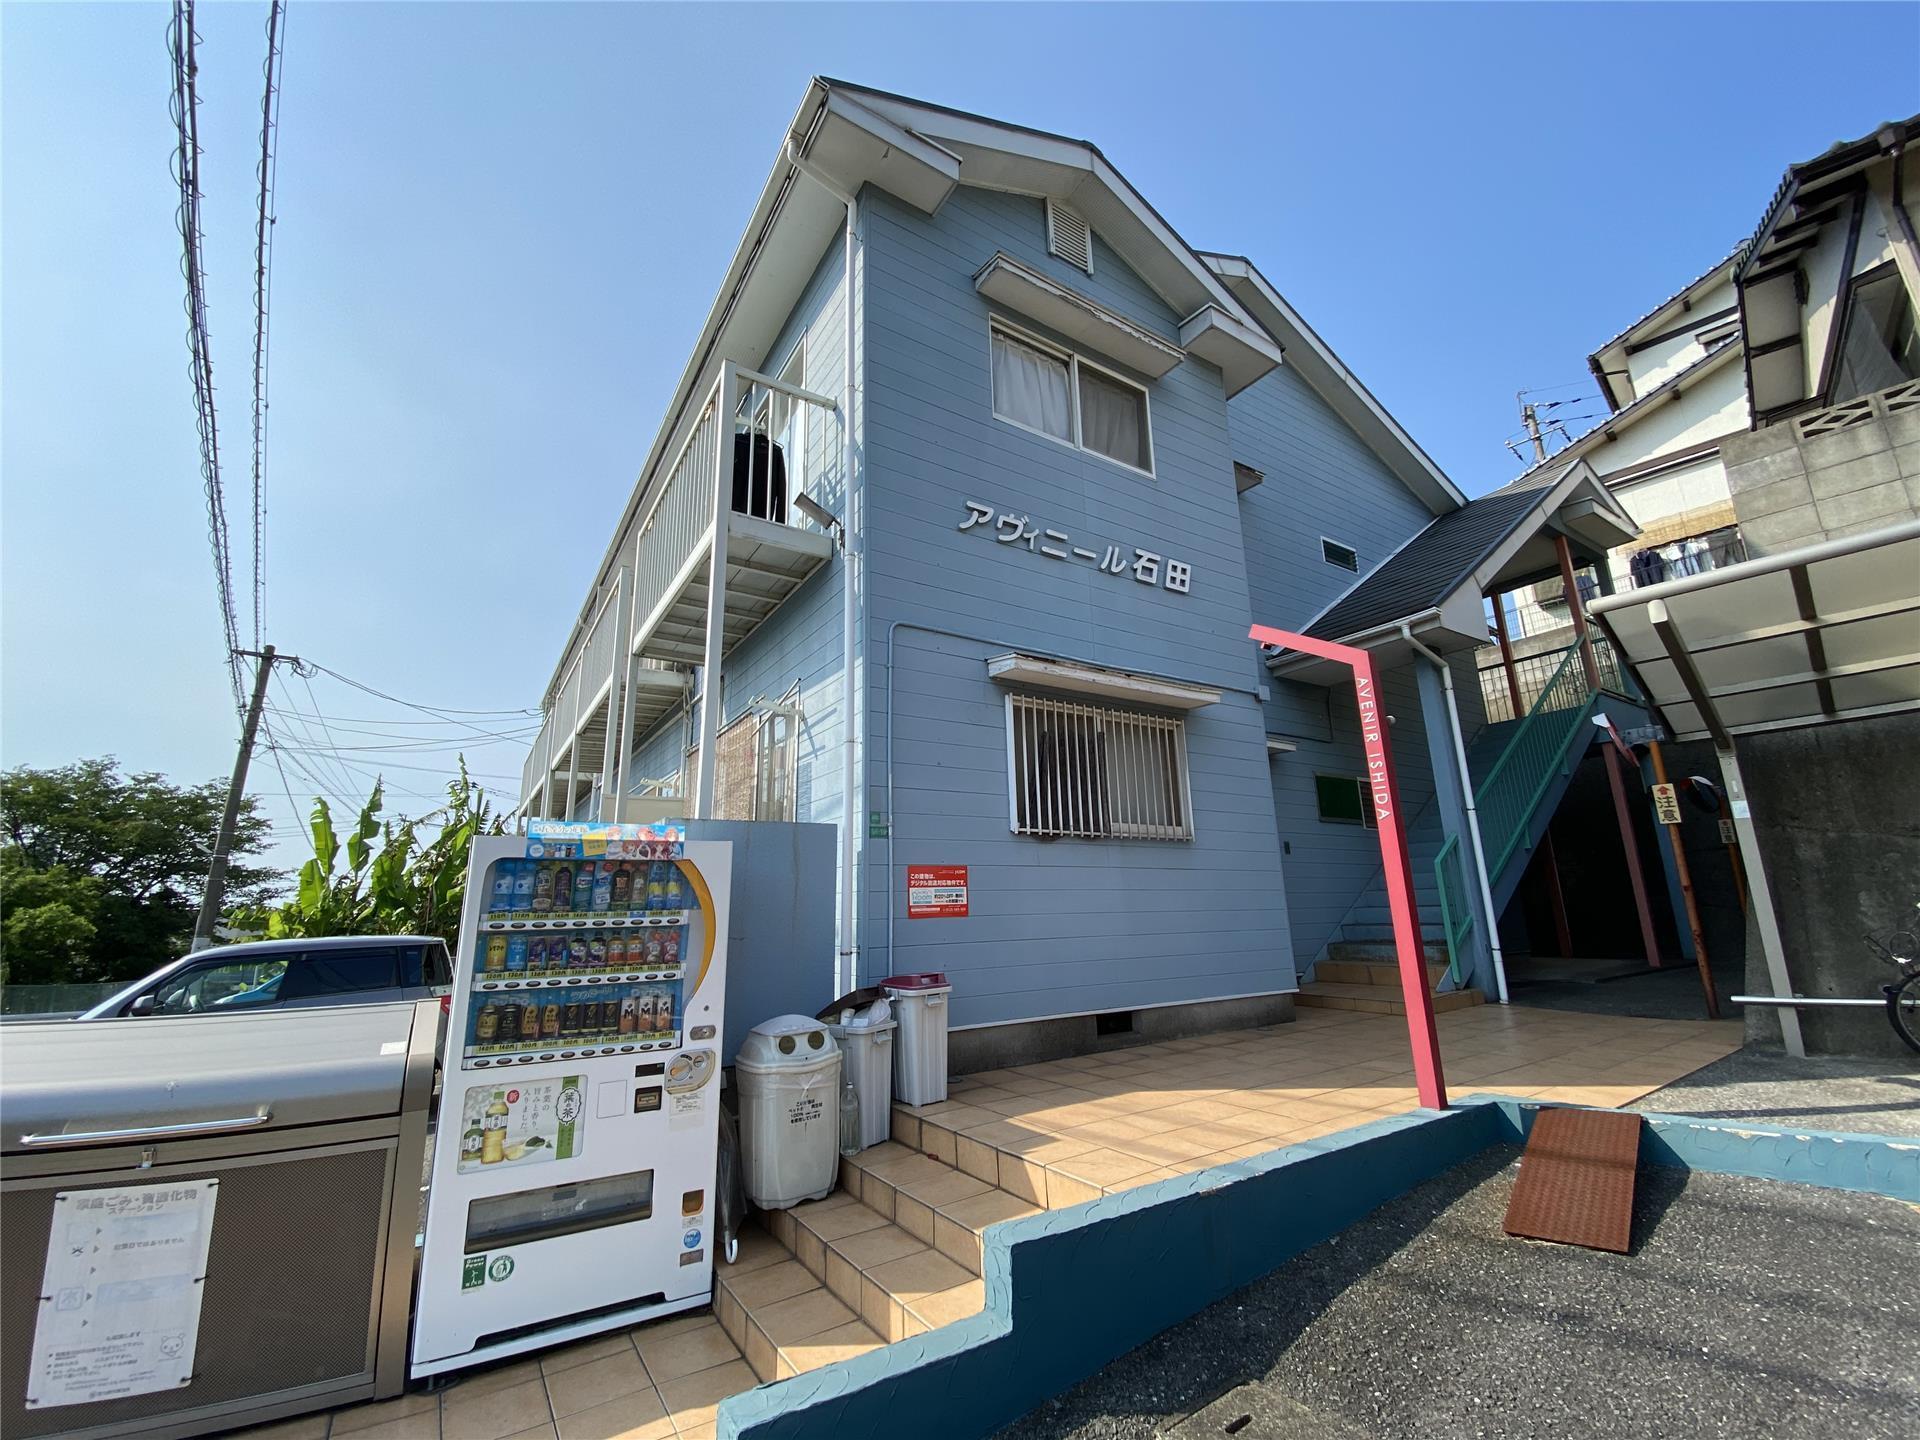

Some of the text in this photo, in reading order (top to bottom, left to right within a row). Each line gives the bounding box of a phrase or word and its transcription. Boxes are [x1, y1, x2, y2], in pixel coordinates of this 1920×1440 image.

[959, 501, 1191, 593] アヴィニール石田
[1357, 677, 1392, 820] AVENIR ISHIDA
[1657, 796, 1679, 822] 注意
[108, 1203, 164, 1216] ステーション
